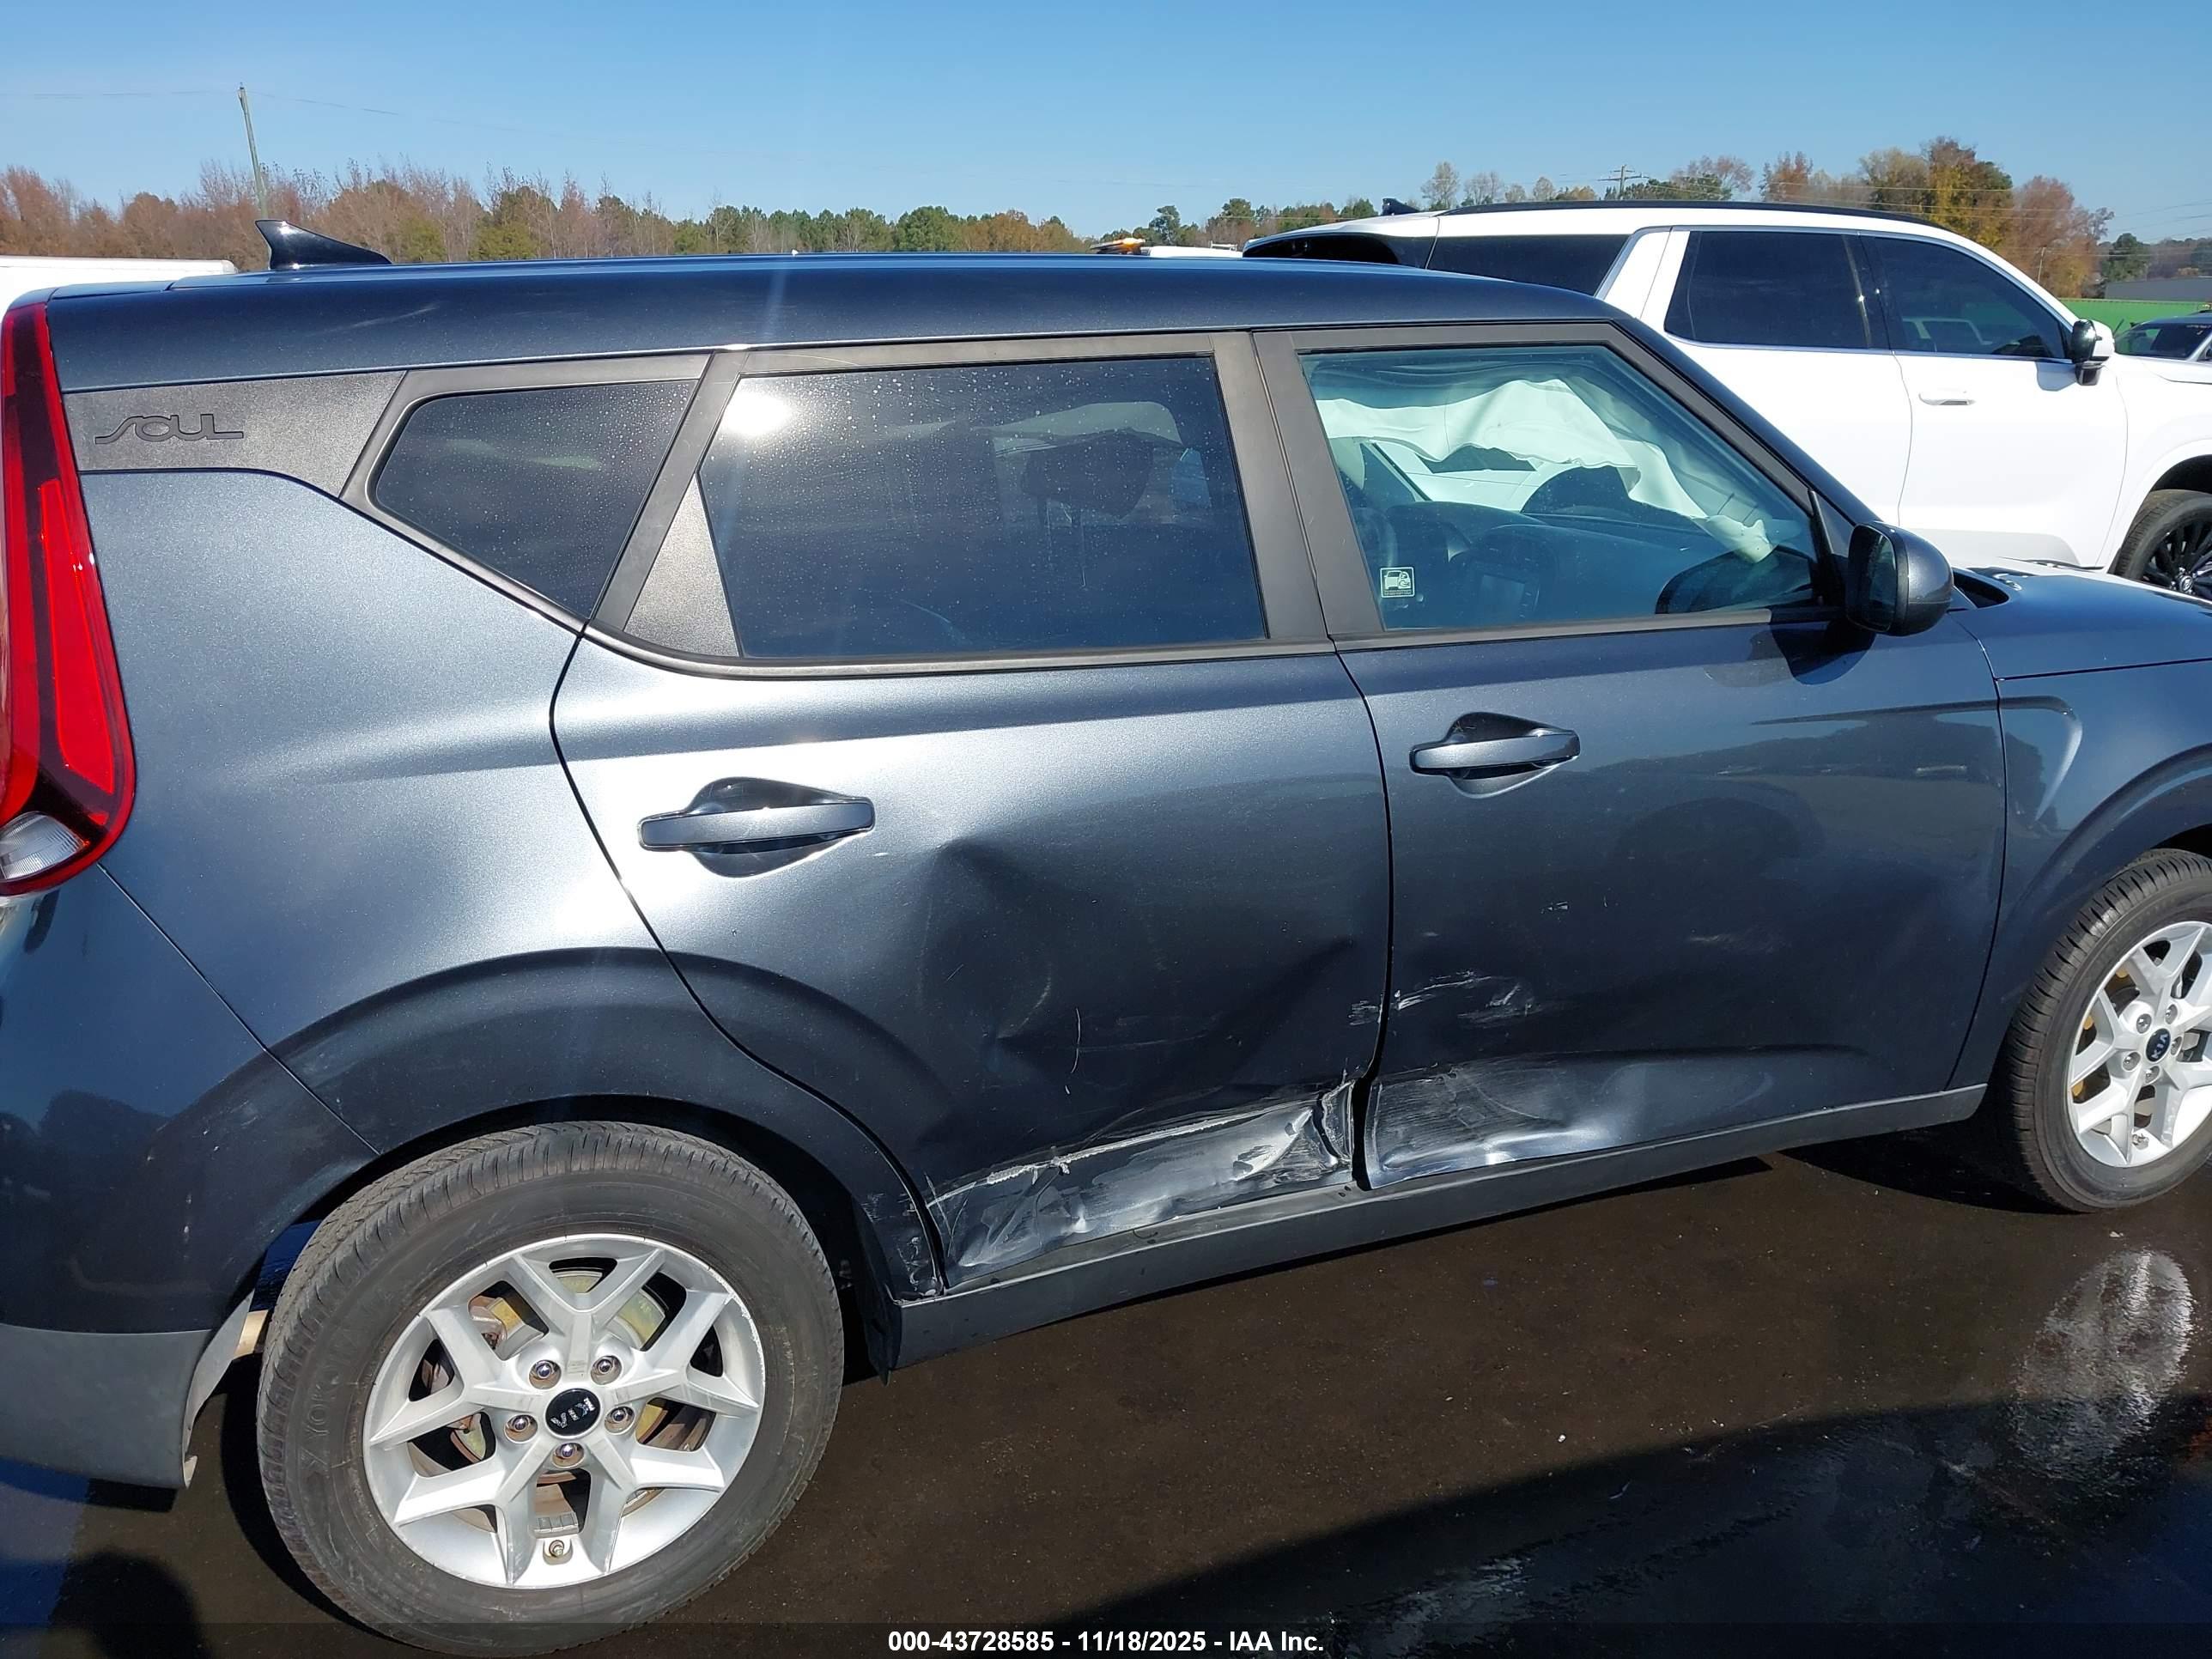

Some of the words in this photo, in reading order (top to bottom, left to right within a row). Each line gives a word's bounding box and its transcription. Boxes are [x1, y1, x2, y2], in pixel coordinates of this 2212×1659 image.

[94, 413, 244, 444] SOUL
[2151, 1033, 2169, 1060] KIA
[549, 1397, 595, 1430] KIA
